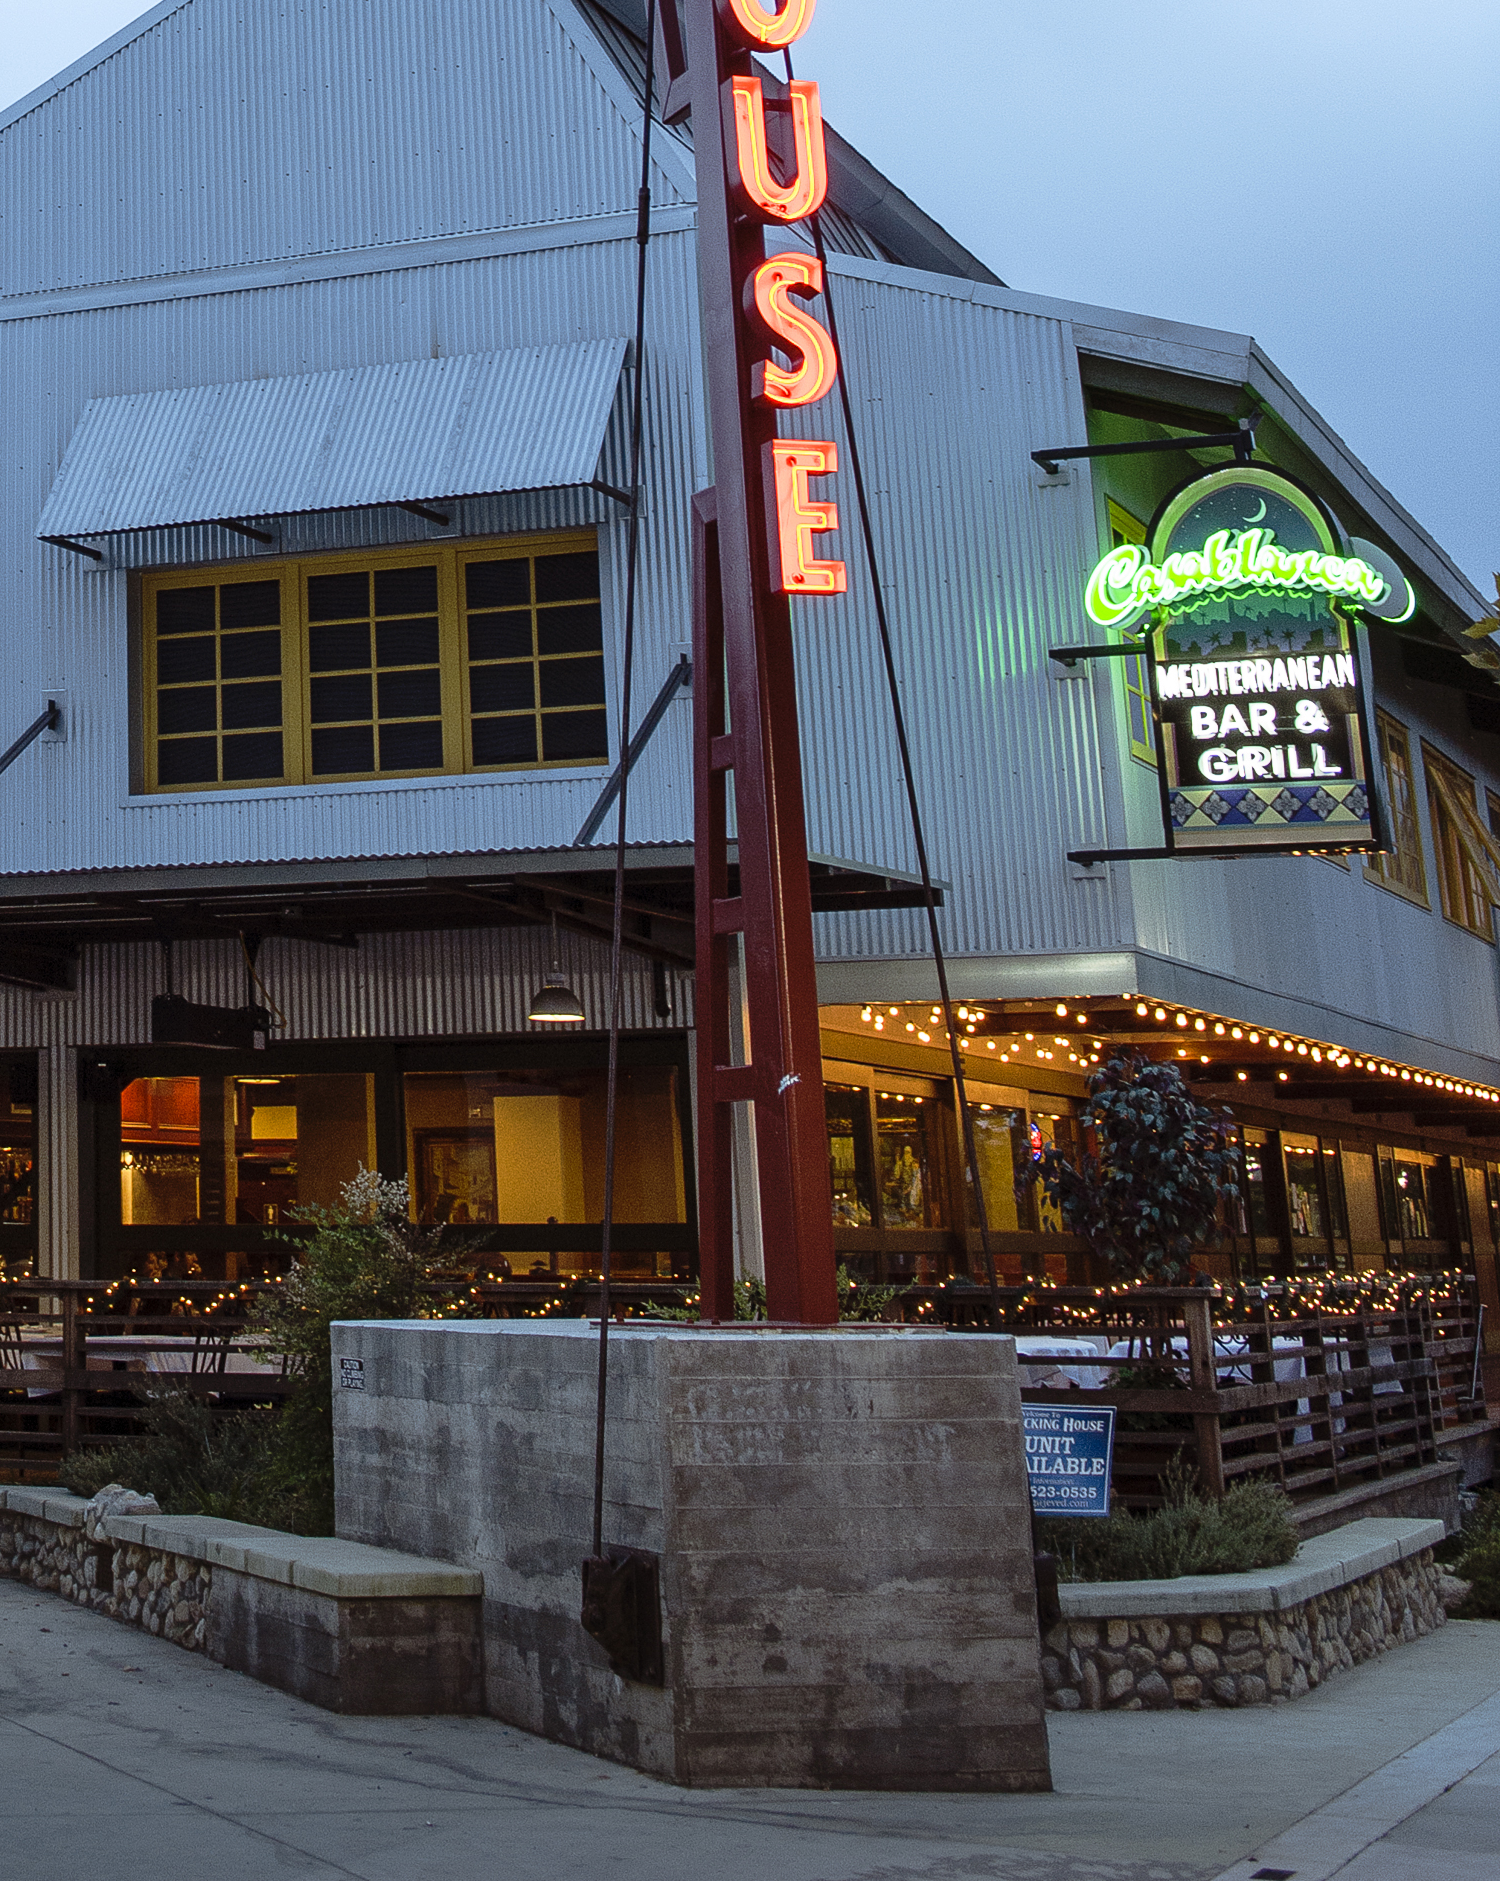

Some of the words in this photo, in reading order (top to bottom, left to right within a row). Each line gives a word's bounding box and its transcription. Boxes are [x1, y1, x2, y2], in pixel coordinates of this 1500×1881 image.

[1084, 527, 1390, 627] Casablanca
[1156, 653, 1357, 701] MEDITERRANEAN
[1190, 701, 1278, 740] BAR
[1294, 699, 1331, 735] &
[1198, 742, 1343, 782] GRILL
[1023, 1418, 1060, 1430] CKING
[1063, 1417, 1104, 1432] HOUSE
[1024, 1435, 1075, 1454] UNIT
[1025, 1456, 1105, 1475] ILABLE
